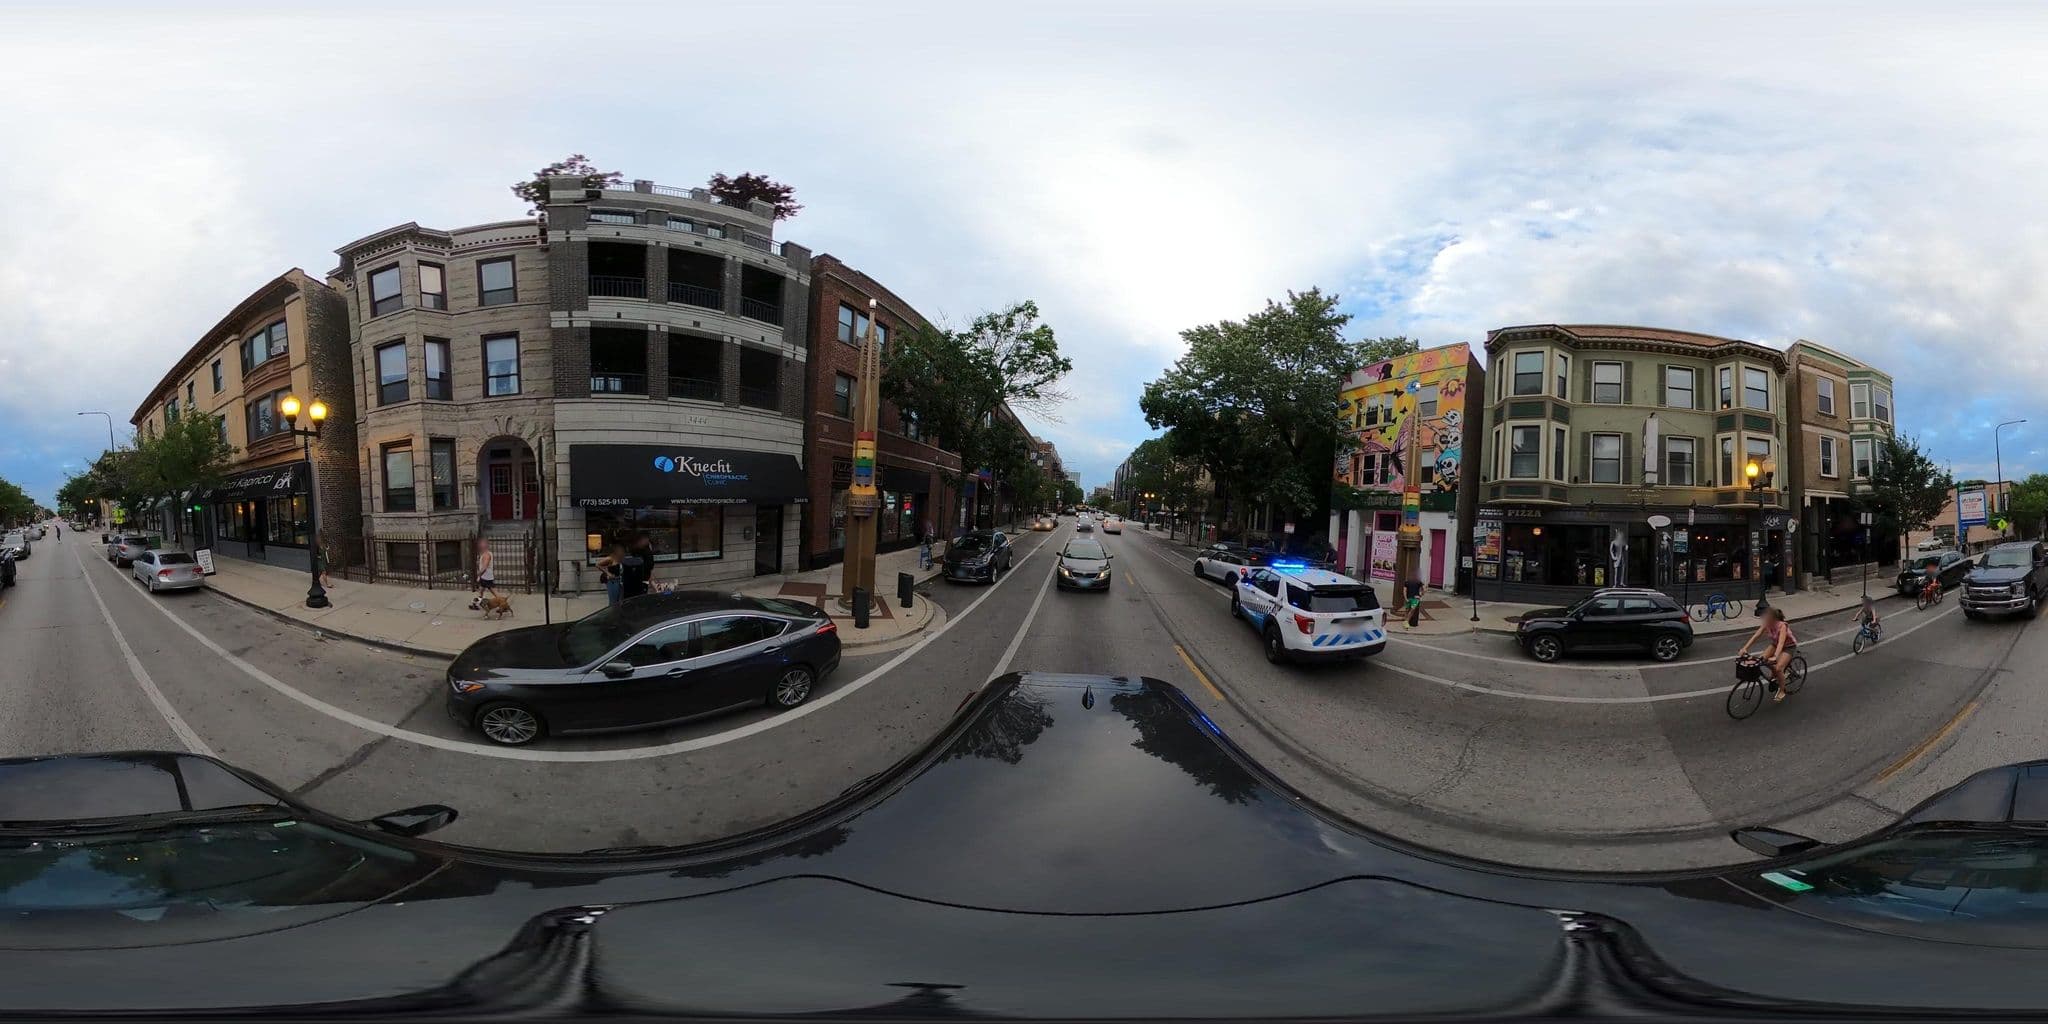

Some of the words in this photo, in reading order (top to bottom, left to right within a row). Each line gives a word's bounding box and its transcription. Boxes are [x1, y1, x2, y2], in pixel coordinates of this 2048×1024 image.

[674, 456, 732, 476] Knecht
[579, 498, 597, 507] (773)
[599, 498, 629, 506] 525-9100
[1507, 509, 1541, 517] PIZZA
